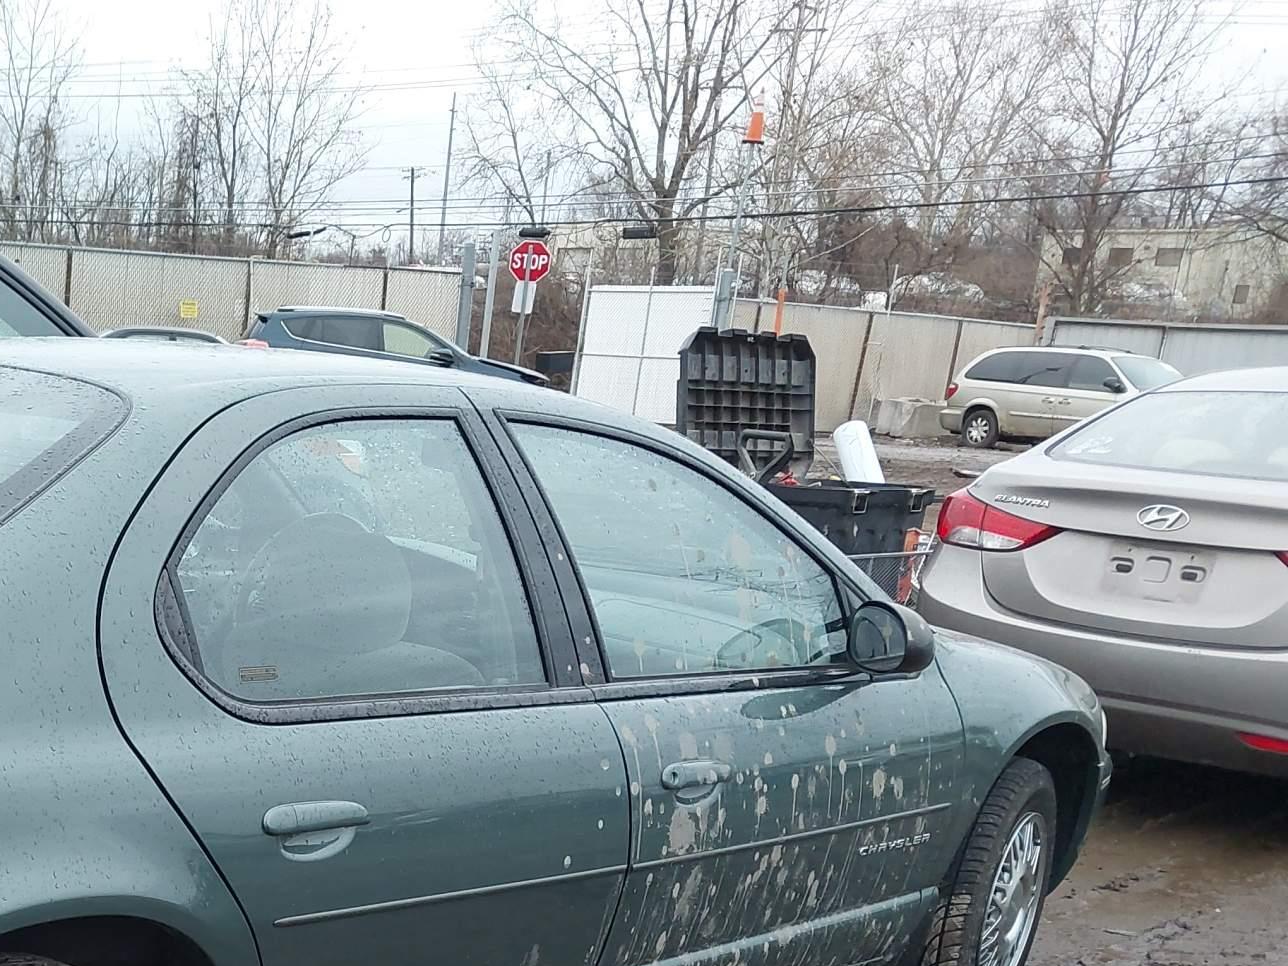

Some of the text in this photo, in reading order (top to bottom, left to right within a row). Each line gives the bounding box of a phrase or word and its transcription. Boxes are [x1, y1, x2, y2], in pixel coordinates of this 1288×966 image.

[512, 252, 548, 271] STOP
[994, 494, 1050, 509] ELANTRA
[859, 832, 931, 856] CHRYSLER
